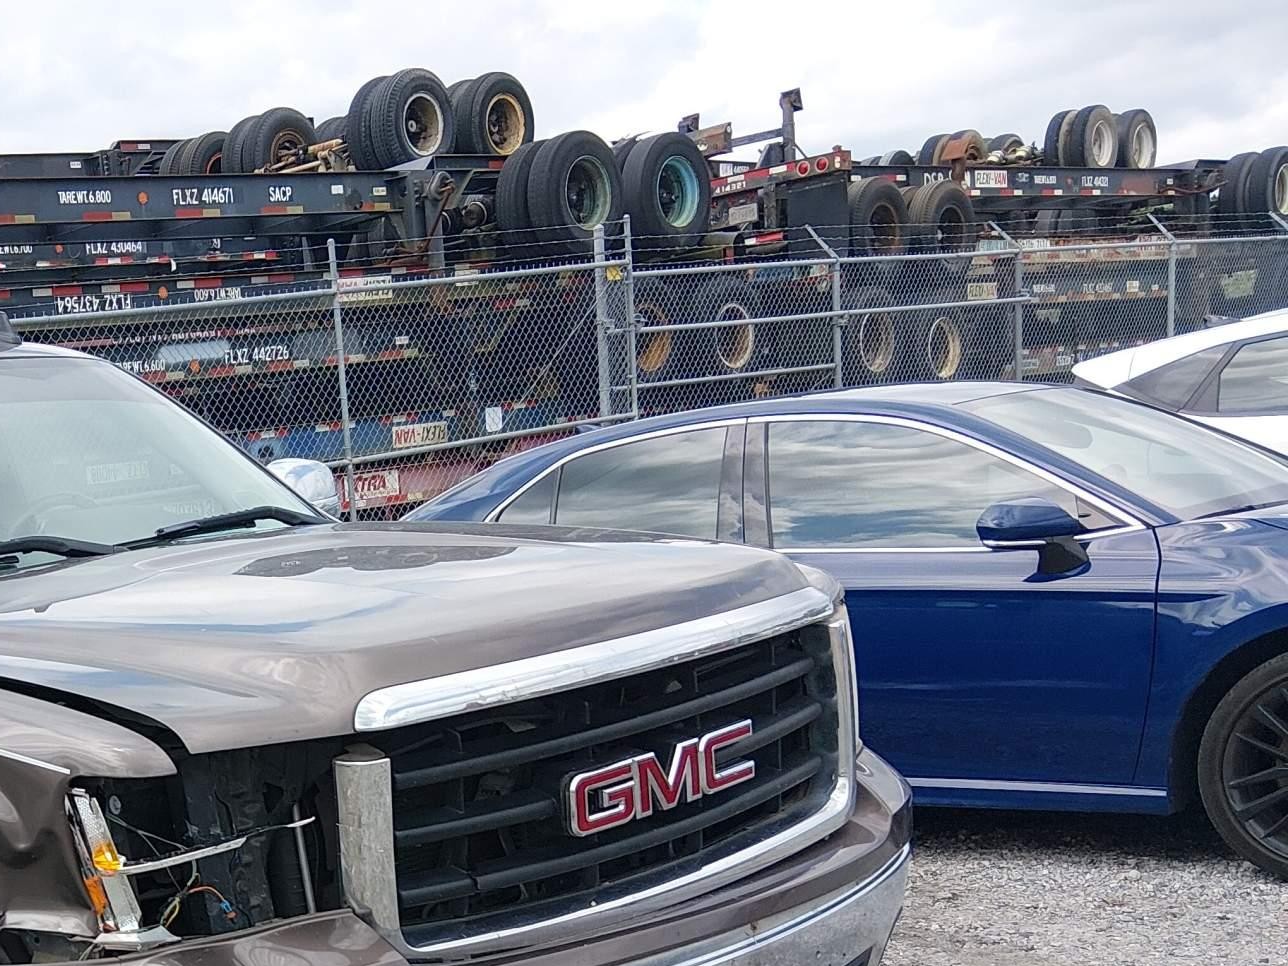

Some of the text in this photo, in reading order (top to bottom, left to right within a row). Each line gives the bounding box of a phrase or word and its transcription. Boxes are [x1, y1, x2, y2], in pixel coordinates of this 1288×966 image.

[172, 187, 234, 205] FLXZ 414671
[269, 186, 292, 201] SACP
[715, 181, 746, 194] 414321
[57, 294, 131, 313] FLXZ 437564
[225, 345, 289, 364] FLXZ 442726
[569, 719, 756, 836] GMC
